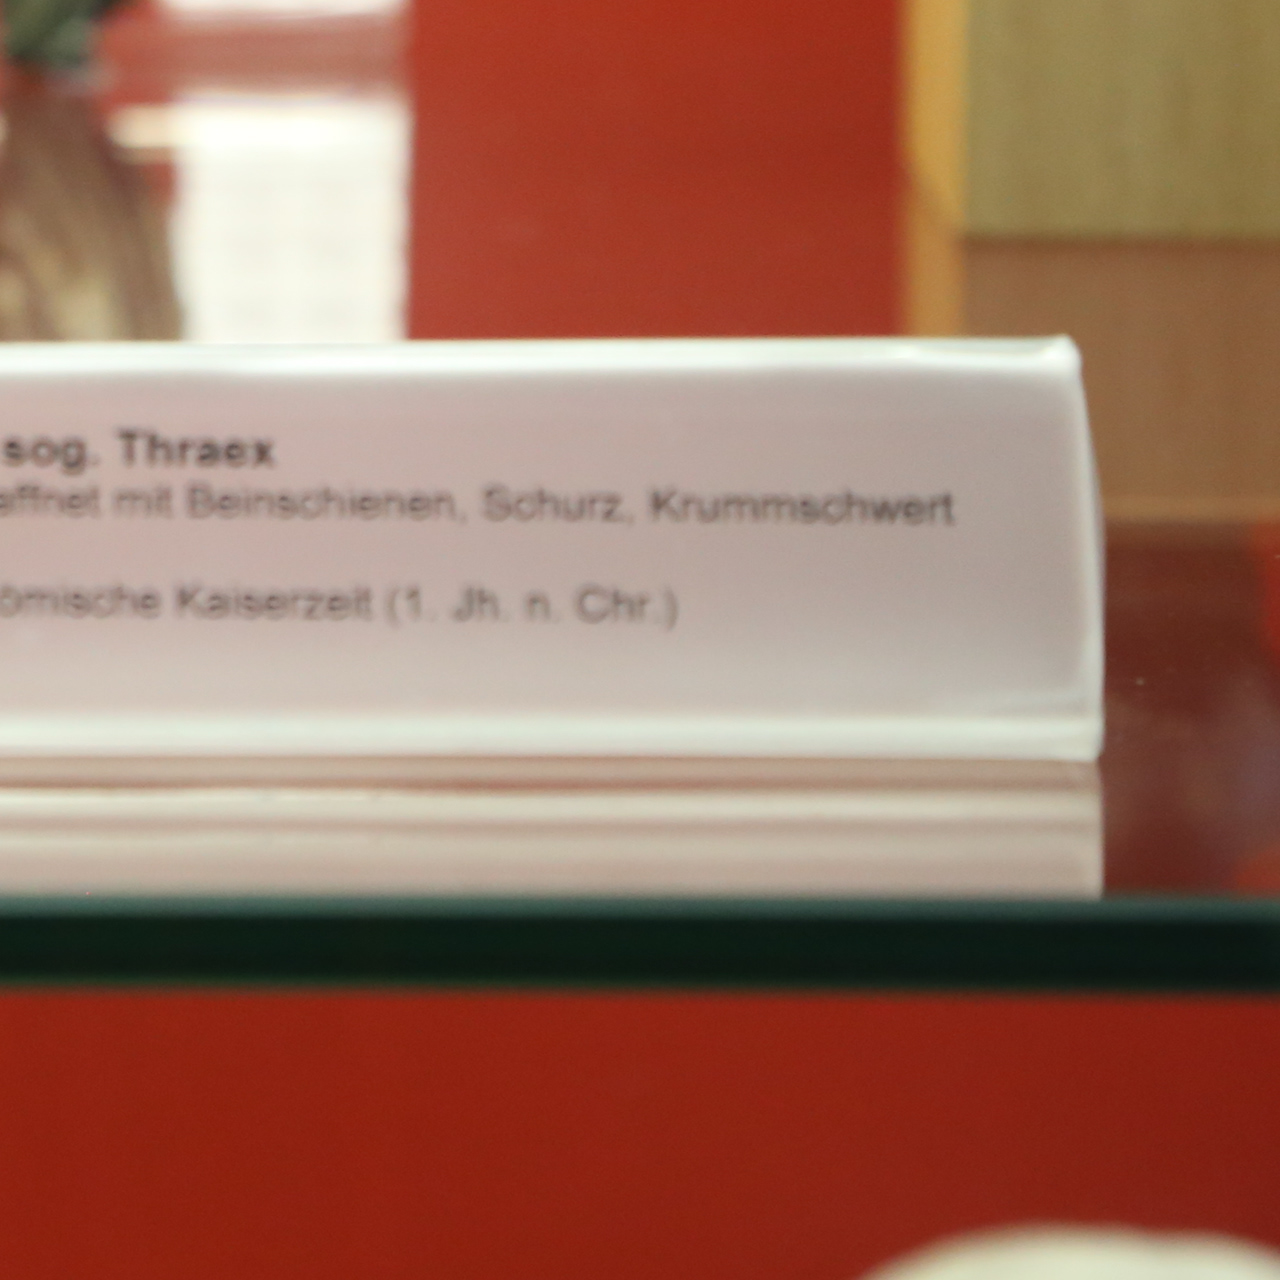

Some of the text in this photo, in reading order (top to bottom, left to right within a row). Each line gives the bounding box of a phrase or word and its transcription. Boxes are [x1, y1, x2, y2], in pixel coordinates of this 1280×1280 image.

[1, 434, 99, 475] sog.
[117, 428, 275, 468] Thraex
[114, 484, 172, 517] mit
[187, 480, 467, 523] Beinschienen,
[483, 485, 633, 525] Schurz,
[649, 486, 955, 525] Krummschwert
[176, 582, 372, 619] Kaiserzeit
